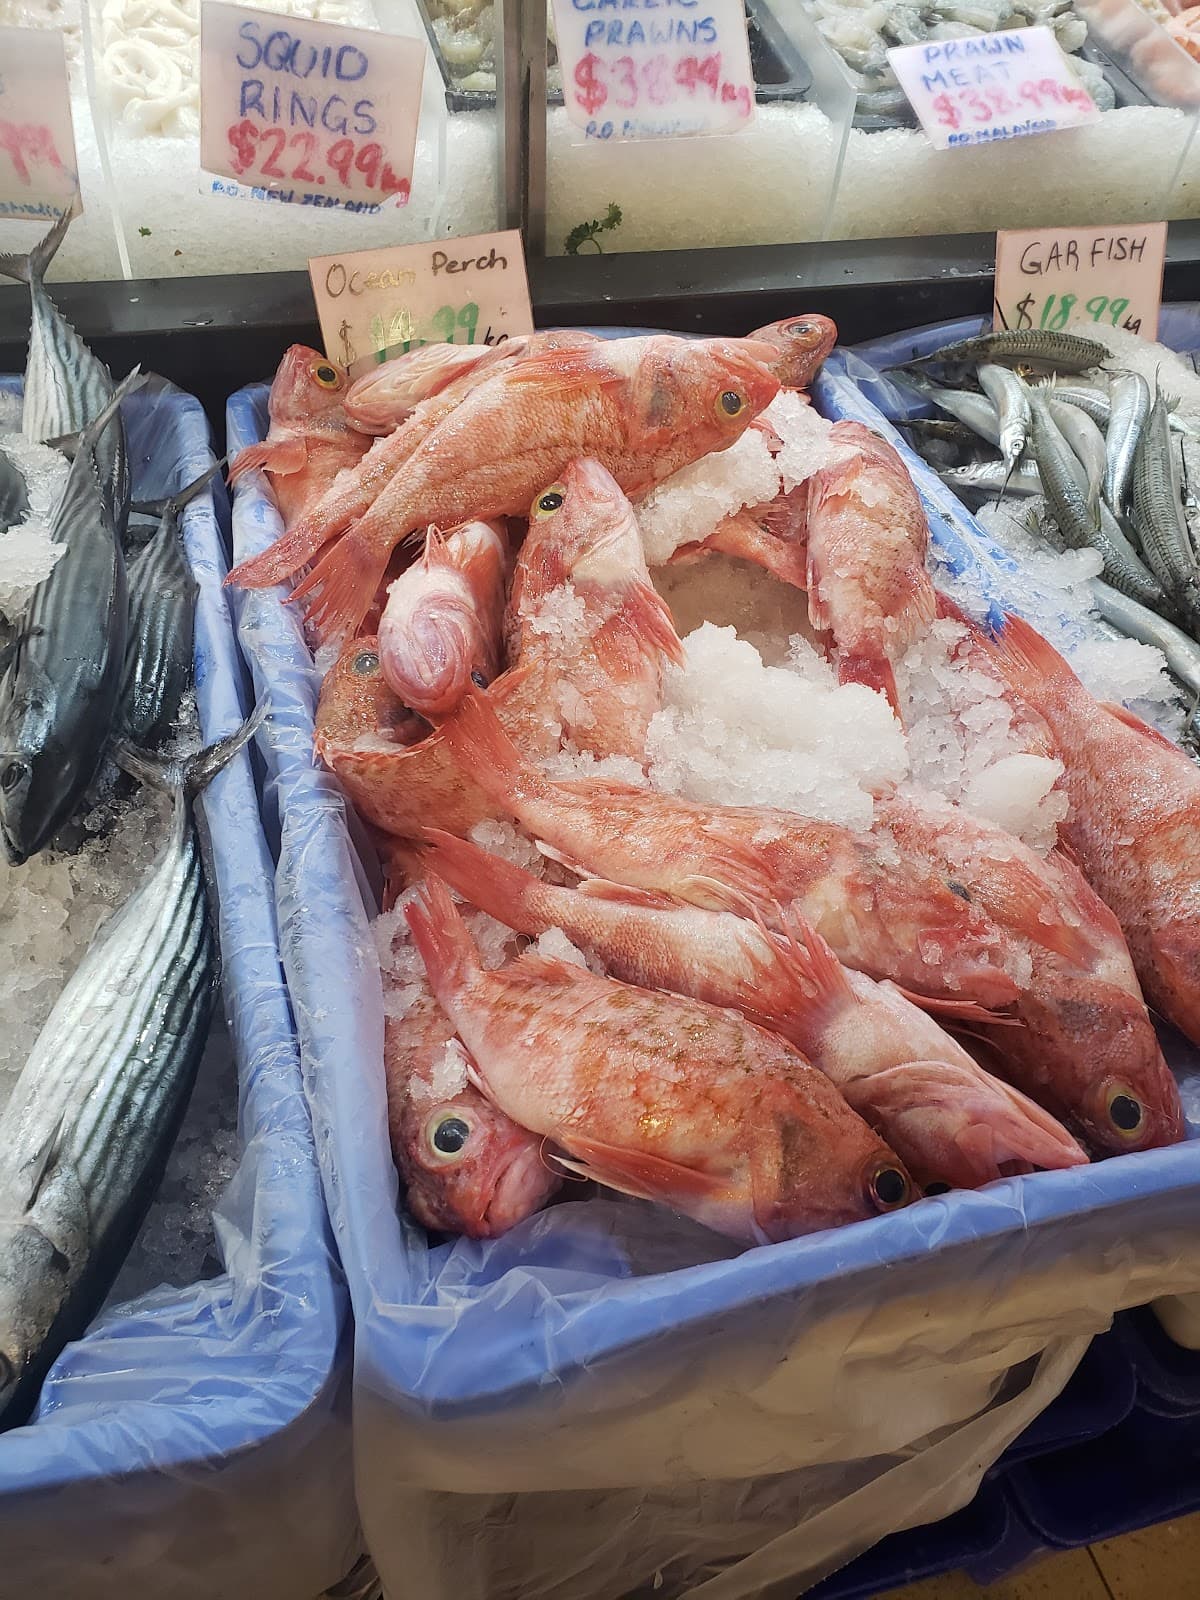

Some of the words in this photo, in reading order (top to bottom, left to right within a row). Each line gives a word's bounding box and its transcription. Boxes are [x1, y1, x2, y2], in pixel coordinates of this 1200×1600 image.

[584, 16, 718, 47] PRAWNS
[924, 35, 1026, 63] PRAWN
[236, 22, 369, 81] SQUID
[920, 61, 1011, 92] MEAT
[240, 79, 378, 135] RINGS
[250, 185, 294, 204] NEW
[325, 262, 416, 298] Ocean
[432, 248, 508, 276] Perch
[1020, 239, 1080, 275] GAR
[1091, 236, 1147, 268] FISH
